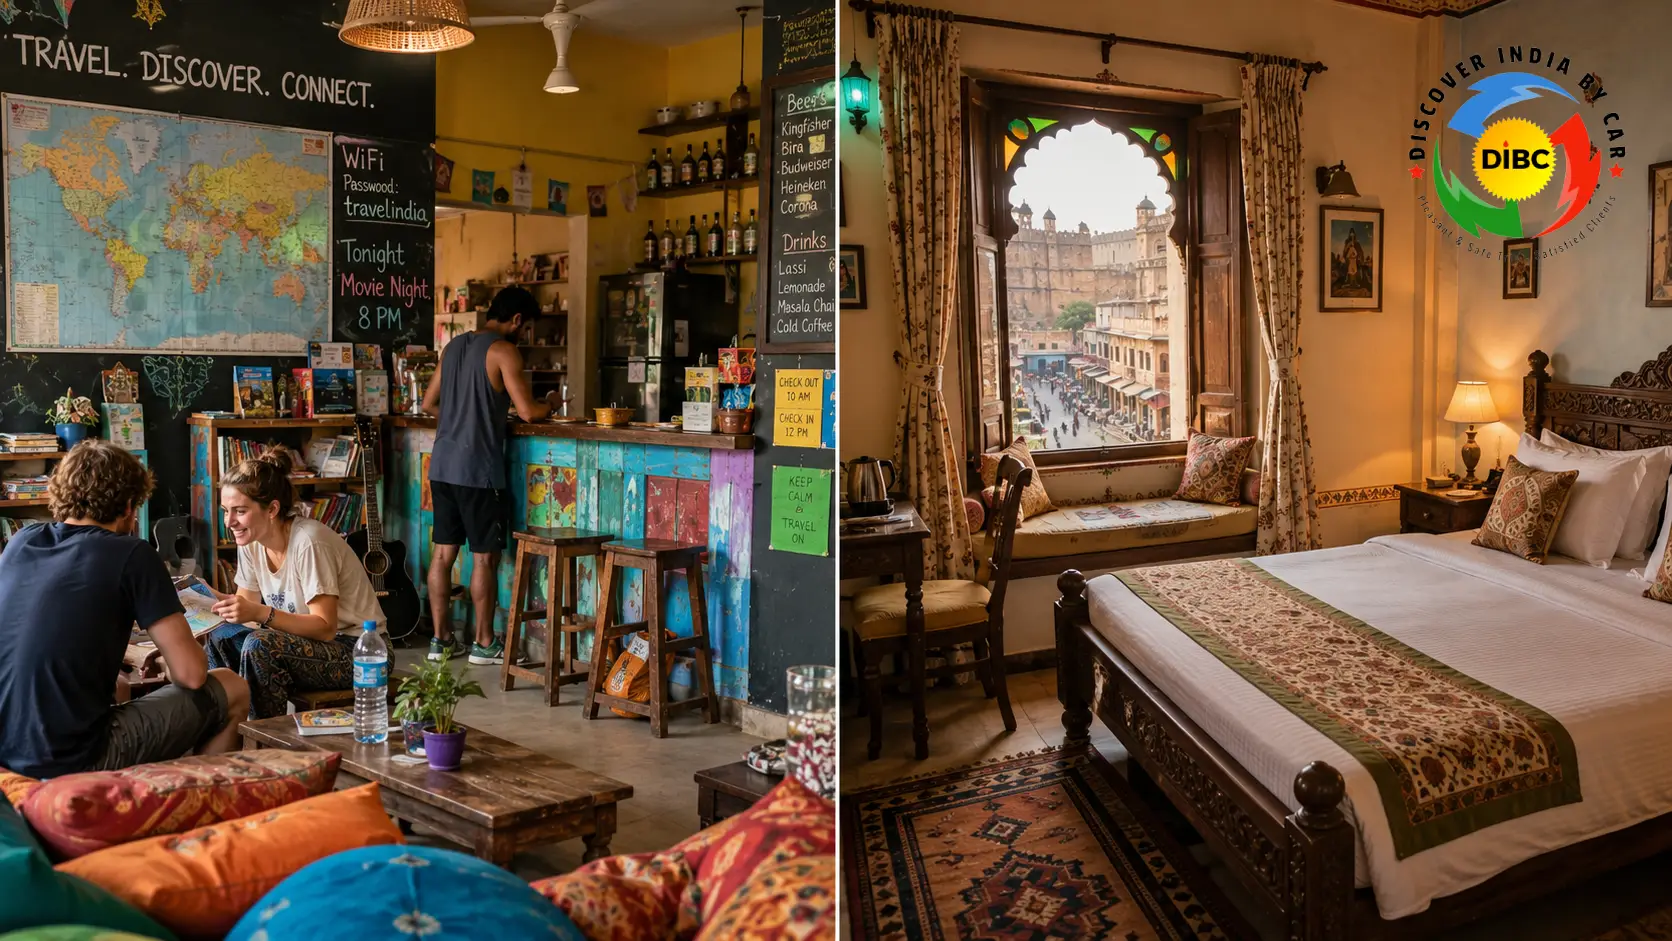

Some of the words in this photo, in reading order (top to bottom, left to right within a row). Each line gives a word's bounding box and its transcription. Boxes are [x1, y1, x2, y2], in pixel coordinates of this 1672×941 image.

[13, 33, 128, 78] TRAVEL.
[140, 50, 270, 96] DISCOVER.
[282, 71, 375, 108] CONNECT.
[781, 117, 832, 138] Kingfisher
[781, 141, 804, 156] Bira
[342, 145, 384, 172] WiFi
[781, 157, 832, 175] Budweiser
[780, 177, 826, 195] Heineken
[780, 199, 818, 214] Corona
[782, 230, 827, 252] Drinks
[340, 239, 406, 273] Tonight
[779, 259, 807, 276] Lassi
[340, 272, 385, 297] Movie
[778, 278, 826, 294] Lemonade
[777, 299, 811, 314] Masala
[813, 297, 835, 313] Chai
[358, 305, 371, 330] 8
[376, 305, 402, 331] PM
[777, 319, 799, 334] Cold
[801, 318, 833, 333] Coffee
[779, 377, 803, 388] CHECK
[804, 377, 819, 388] OUT
[787, 391, 796, 402] 10
[798, 391, 811, 402] AM
[779, 413, 803, 424] CHECK
[806, 414, 814, 425] IN
[785, 427, 794, 437] 12
[797, 427, 808, 437] PM
[789, 475, 813, 487] KEEP
[788, 491, 813, 503] CALM
[781, 517, 817, 532] TRAVEL
[791, 533, 805, 544] ON
